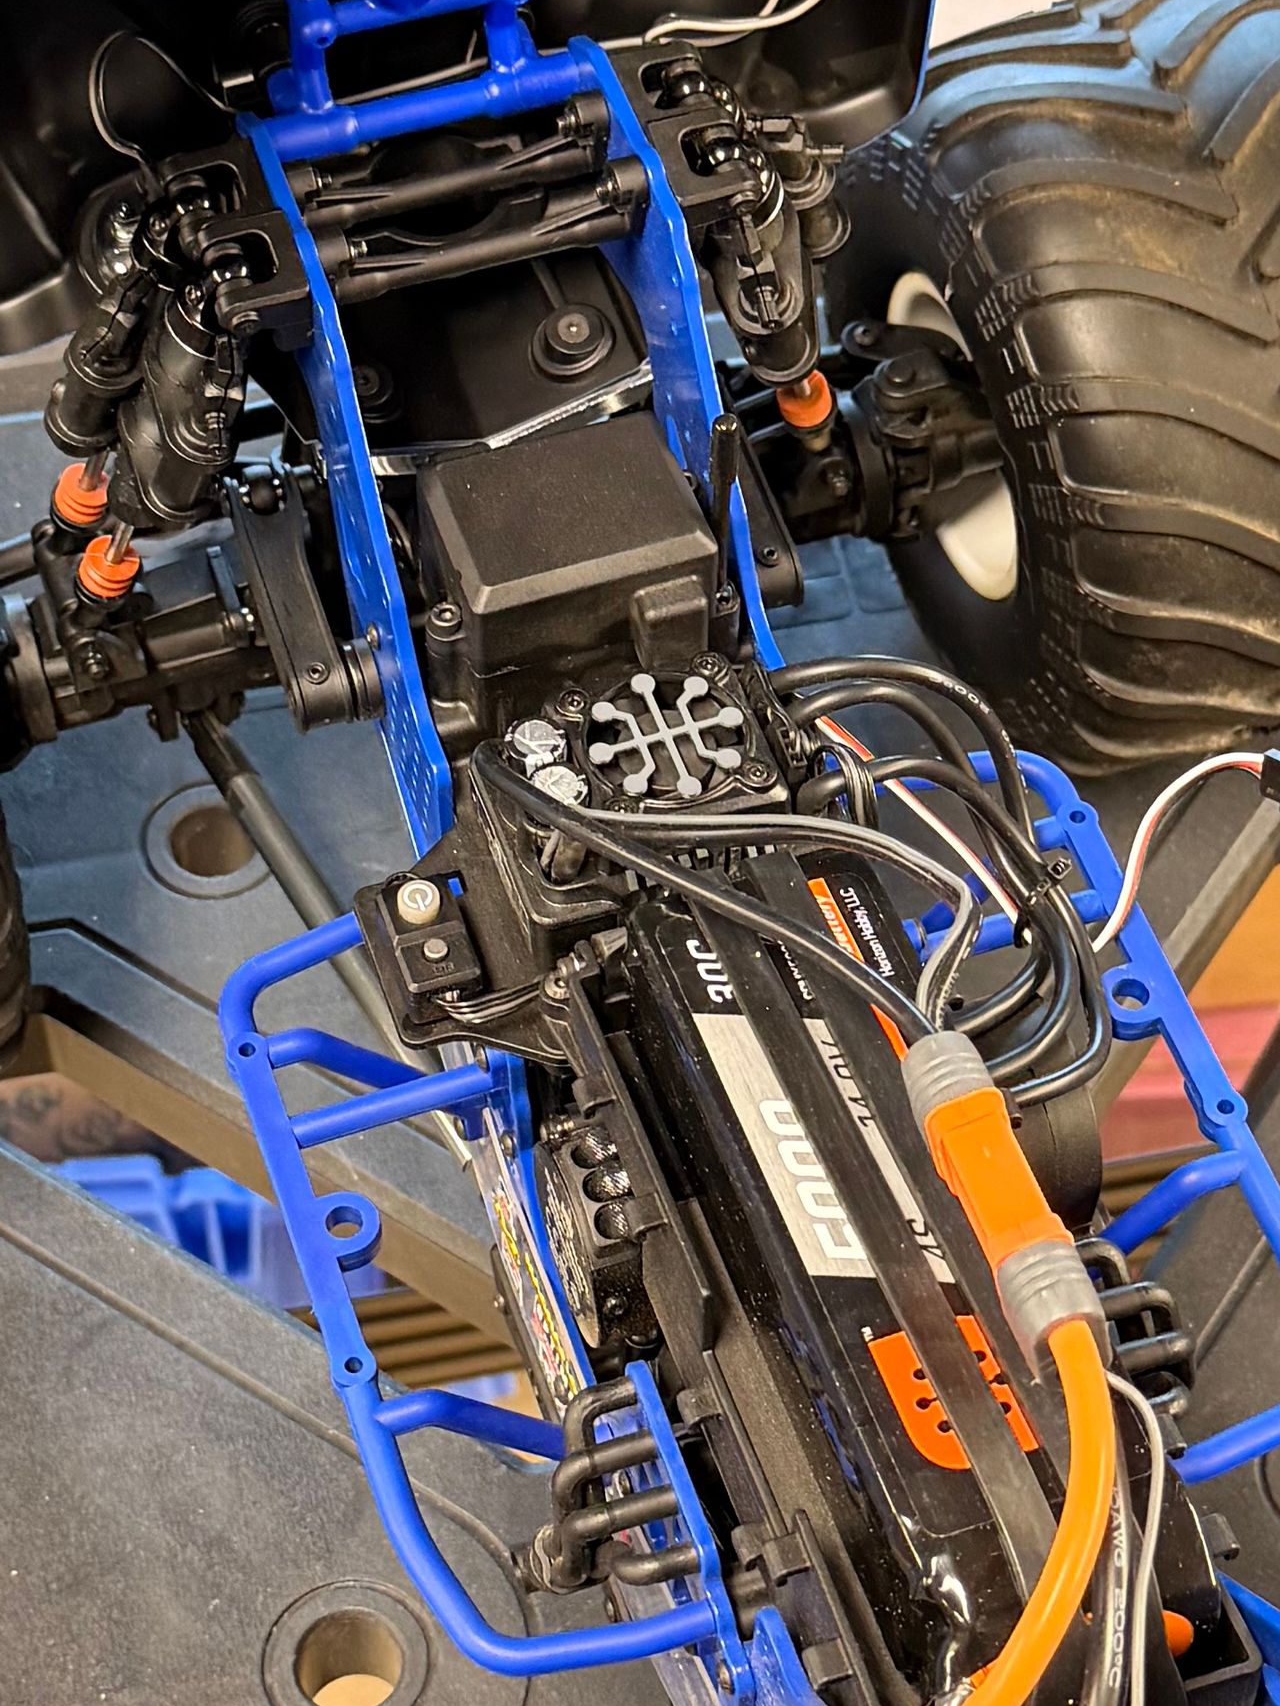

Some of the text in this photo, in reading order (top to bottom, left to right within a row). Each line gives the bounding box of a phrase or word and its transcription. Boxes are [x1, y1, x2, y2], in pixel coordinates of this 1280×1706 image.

[686, 939, 733, 1003] 30C
[840, 887, 895, 977] Horizon Hobby, LLC
[1111, 1488, 1125, 1568] 0AWG
